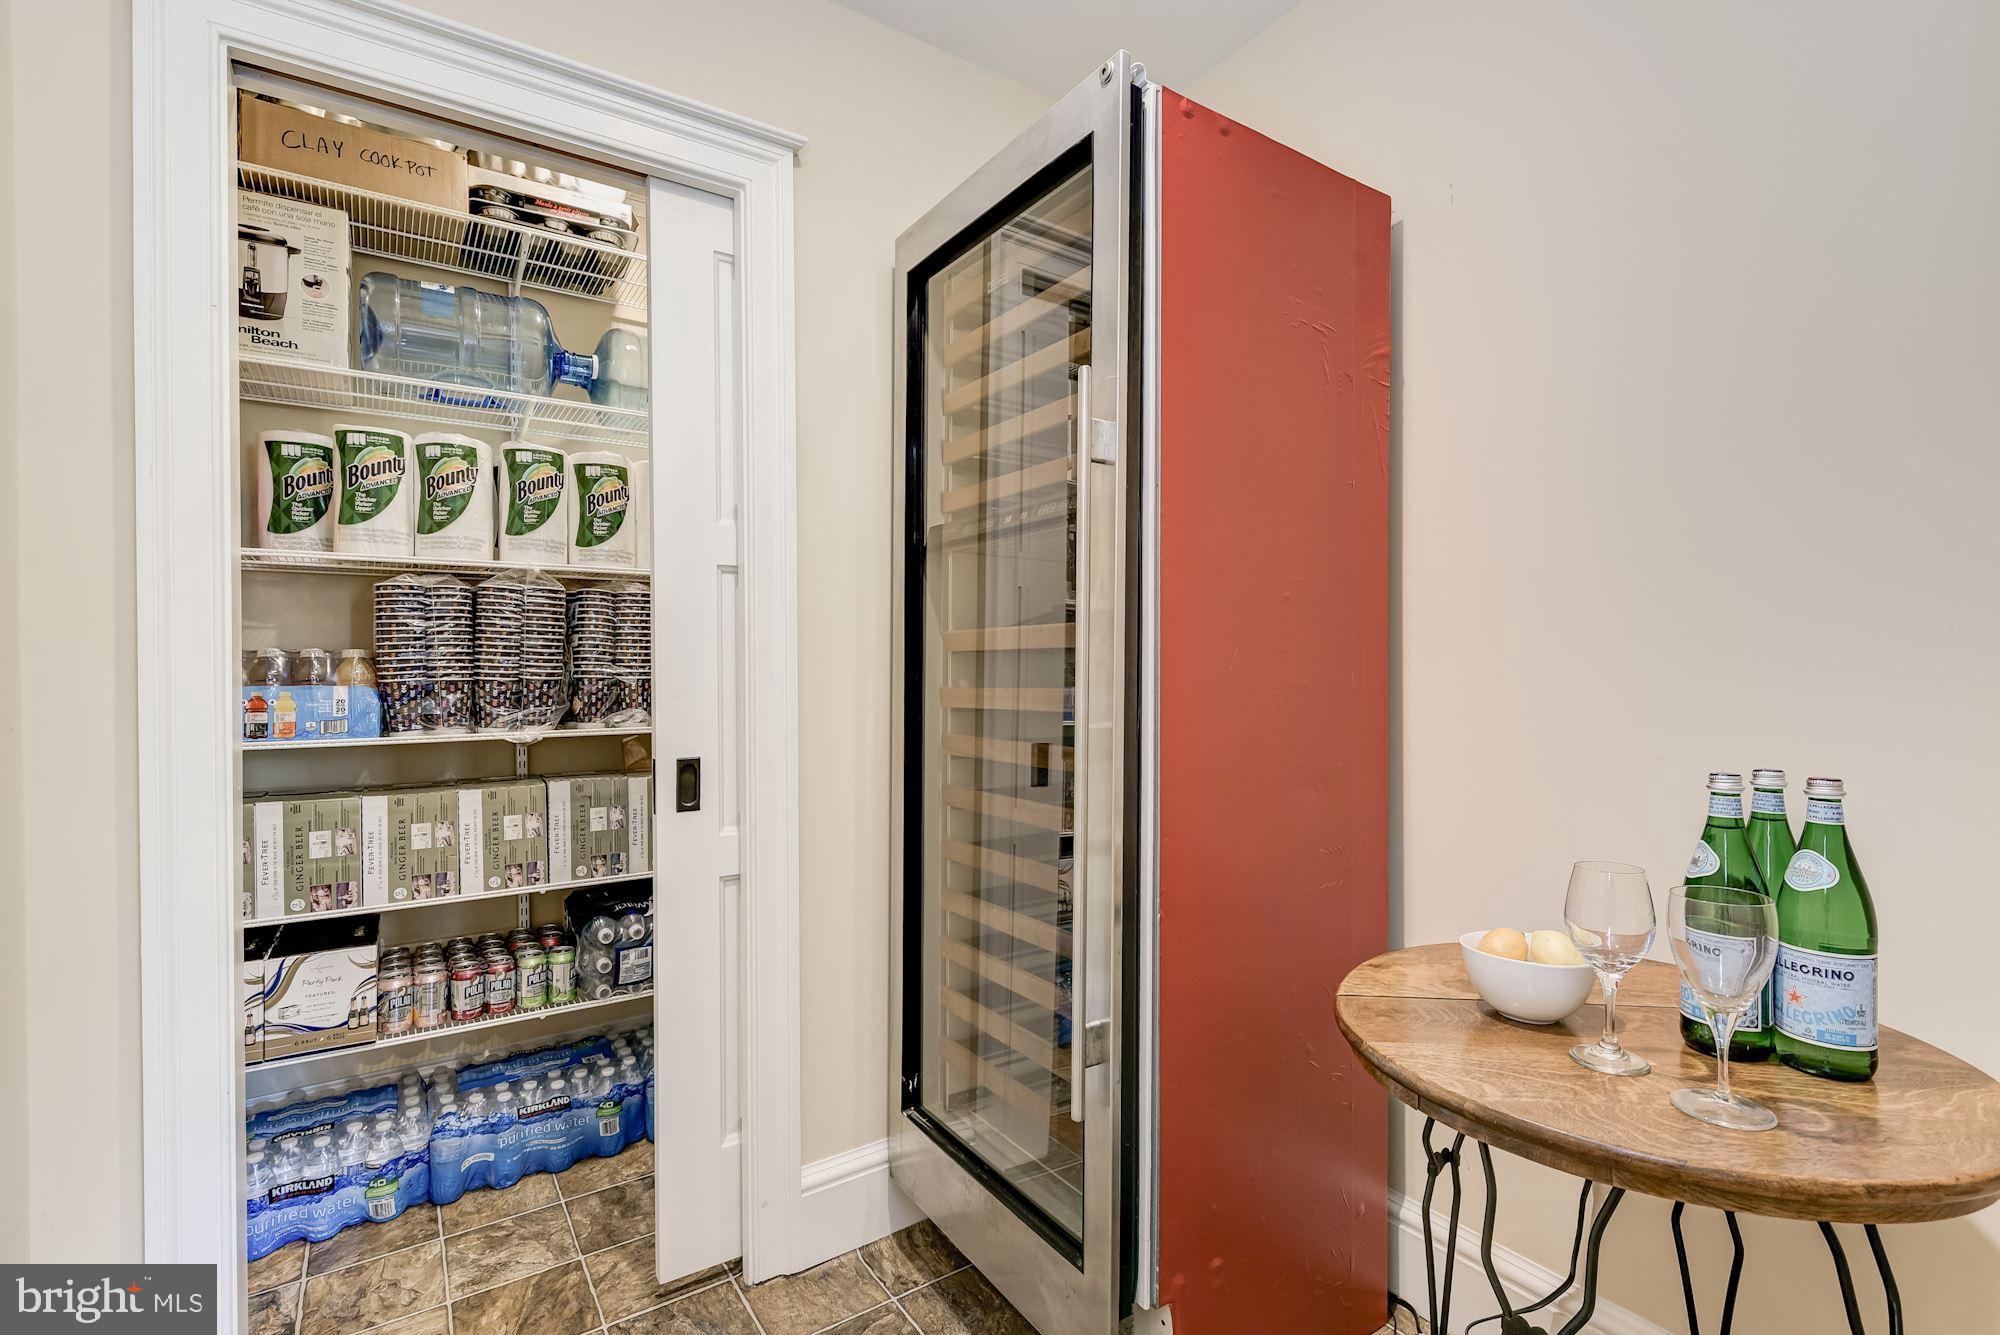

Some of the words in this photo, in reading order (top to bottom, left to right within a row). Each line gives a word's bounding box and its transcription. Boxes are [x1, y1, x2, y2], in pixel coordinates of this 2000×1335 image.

[281, 130, 344, 158] CLAY
[359, 148, 403, 169] COOK
[405, 160, 439, 178] POT
[242, 195, 274, 208] Permite
[275, 201, 313, 216] dispensar
[242, 203, 260, 212] café
[278, 211, 294, 219] una
[295, 215, 311, 223] sola
[313, 219, 336, 228] mano
[251, 335, 298, 350] Beach
[348, 456, 406, 488] Bounty
[361, 478, 398, 490] ADVANCED
[426, 466, 478, 499] Bounty
[438, 486, 471, 499] ADVANCED
[517, 472, 564, 502] Bounty
[529, 492, 558, 503] ADVANCED
[587, 486, 630, 515] Bounty
[295, 826, 304, 850] BEER
[398, 818, 407, 840] BEER
[367, 831, 375, 875] FEVER-TREE
[492, 835, 500, 870] GINGER
[579, 827, 587, 860] GINGER
[261, 839, 269, 886] FEVER-TREE
[295, 855, 304, 892] GINGER
[398, 845, 407, 881] GINGER
[302, 979, 324, 987] Party
[325, 975, 342, 983] Pack
[490, 979, 511, 992] POLAR
[519, 1096, 570, 1116] KIRKLAND
[599, 1101, 614, 1109] 40
[273, 1124, 332, 1143] KIRKLAND
[499, 1121, 551, 1149] purified
[554, 1114, 591, 1132] water
[271, 1177, 334, 1198] KIRKLAND
[369, 1178, 387, 1188] 40
[312, 1195, 358, 1219] water
